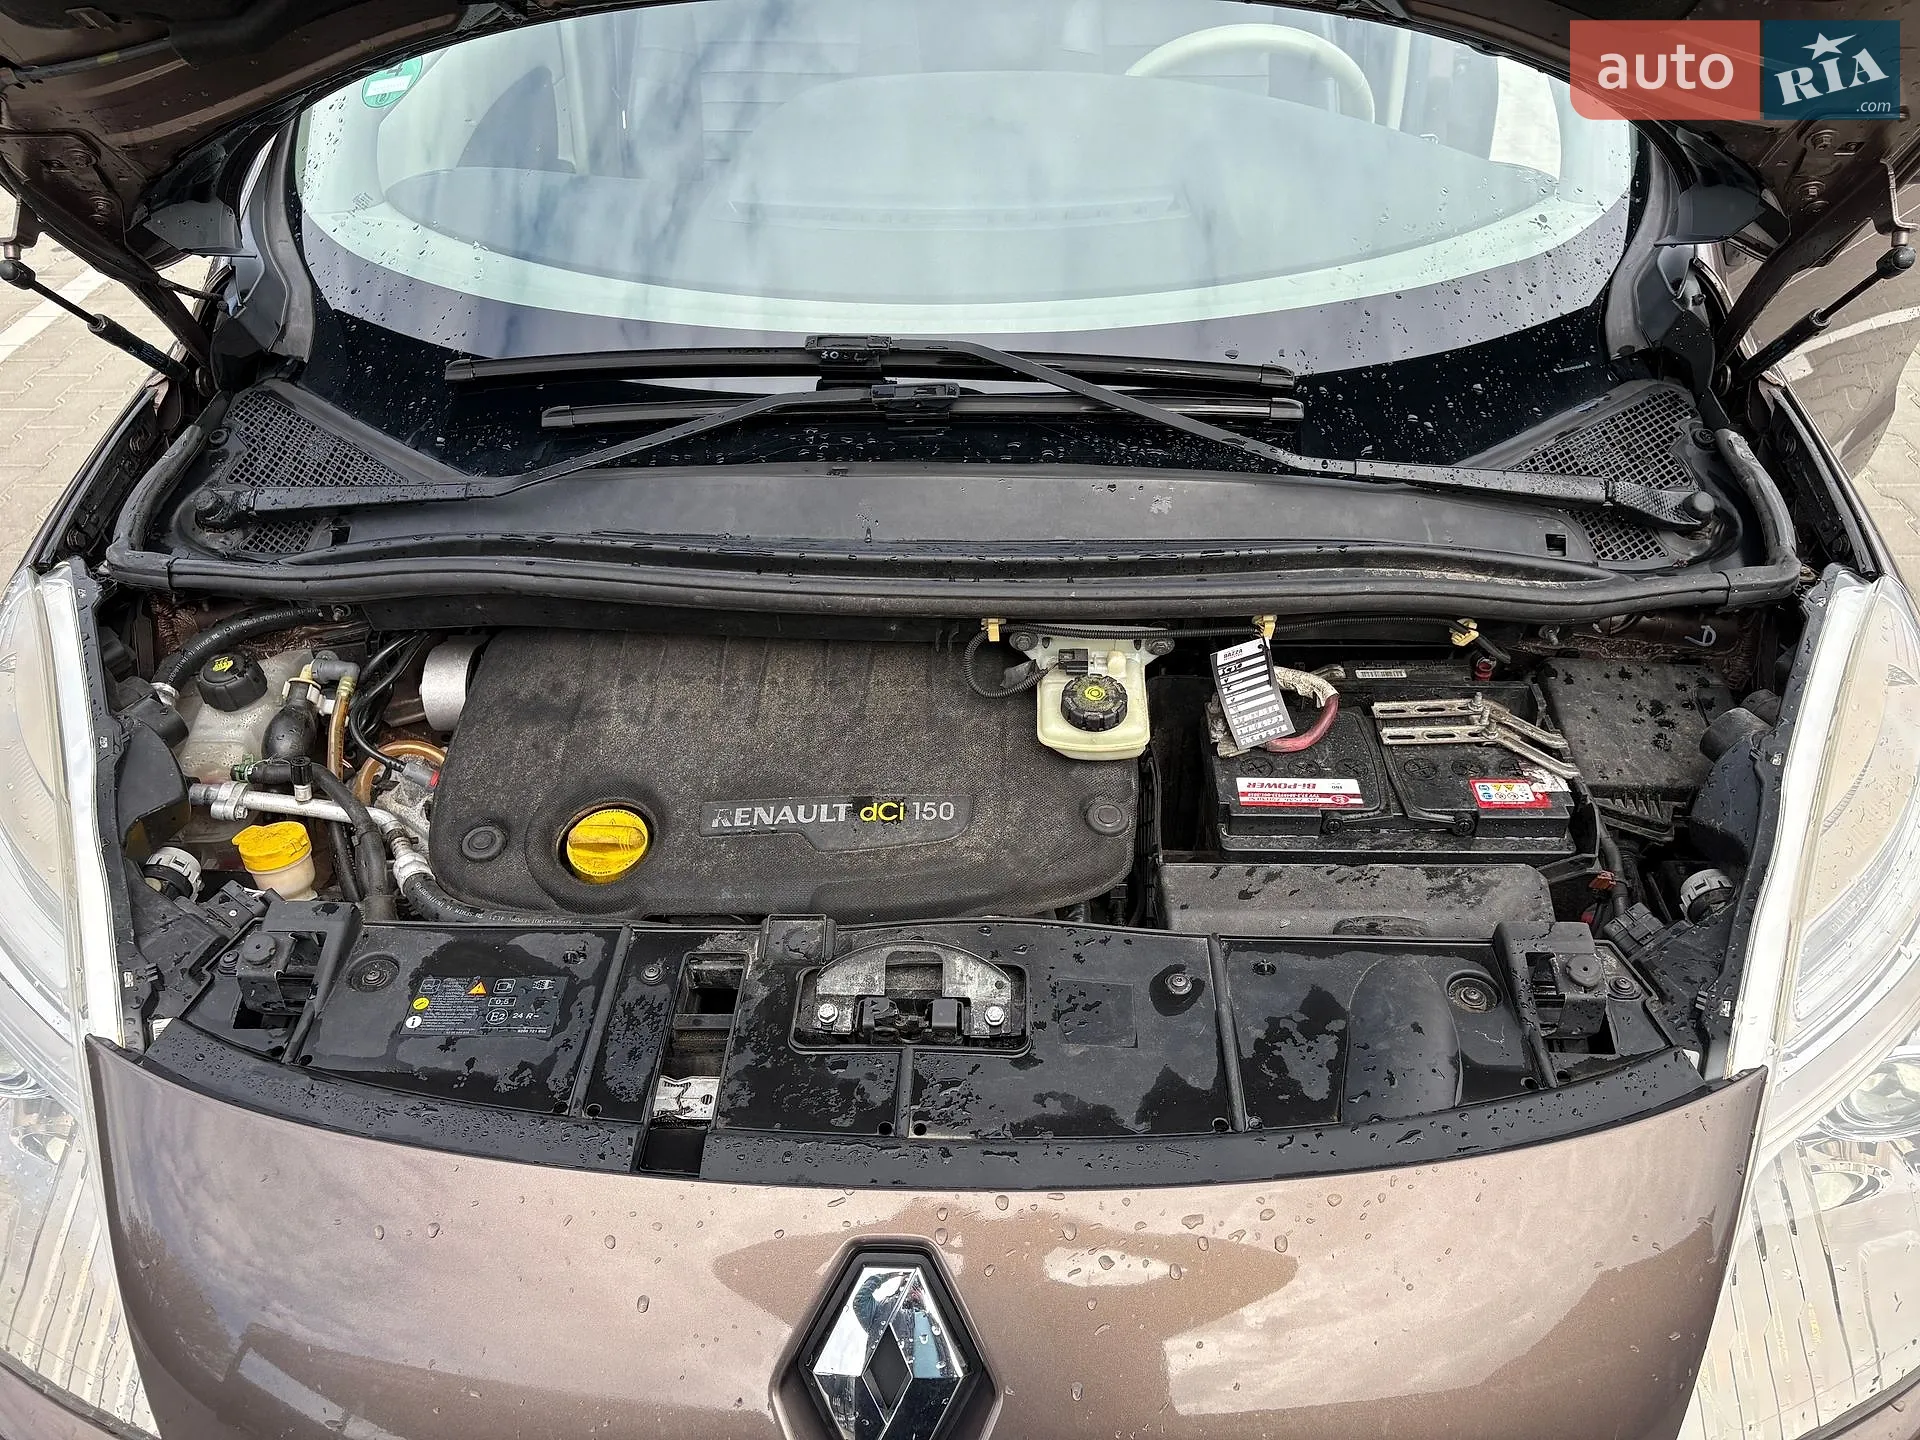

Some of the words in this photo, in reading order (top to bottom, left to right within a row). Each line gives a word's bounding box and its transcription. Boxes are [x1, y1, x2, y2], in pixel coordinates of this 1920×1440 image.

[711, 803, 853, 828] RENAULT
[859, 802, 905, 822] dCi
[913, 801, 955, 821] 150
